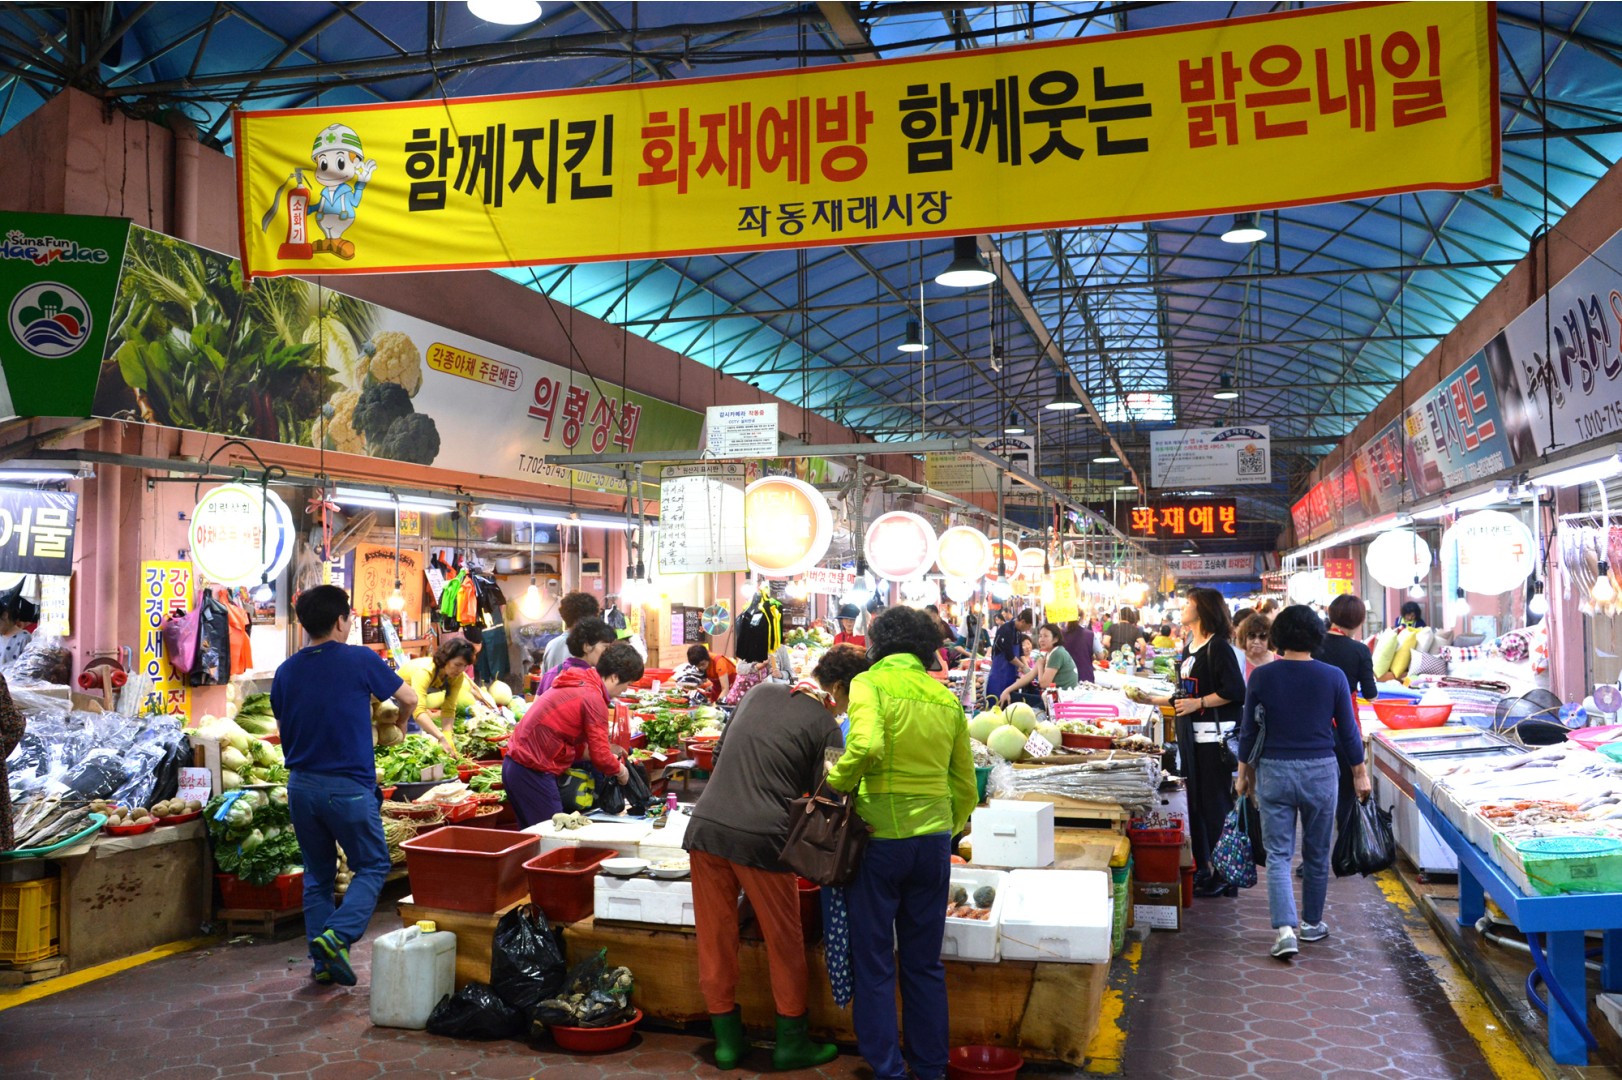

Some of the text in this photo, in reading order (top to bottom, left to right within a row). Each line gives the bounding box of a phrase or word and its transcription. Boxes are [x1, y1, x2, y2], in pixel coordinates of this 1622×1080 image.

[404, 25, 1447, 212] 함께지킨 화재예방 함께웃는 밝은내일
[292, 199, 302, 241] 소화기
[737, 190, 952, 237] 좌동재래시장
[11, 235, 70, 248] Sun&Fun
[433, 347, 519, 388] 각종야채 주문배달
[528, 376, 643, 453] 의령상회
[1425, 364, 1496, 462] 리치랜드
[683, 466, 699, 475] 원산지
